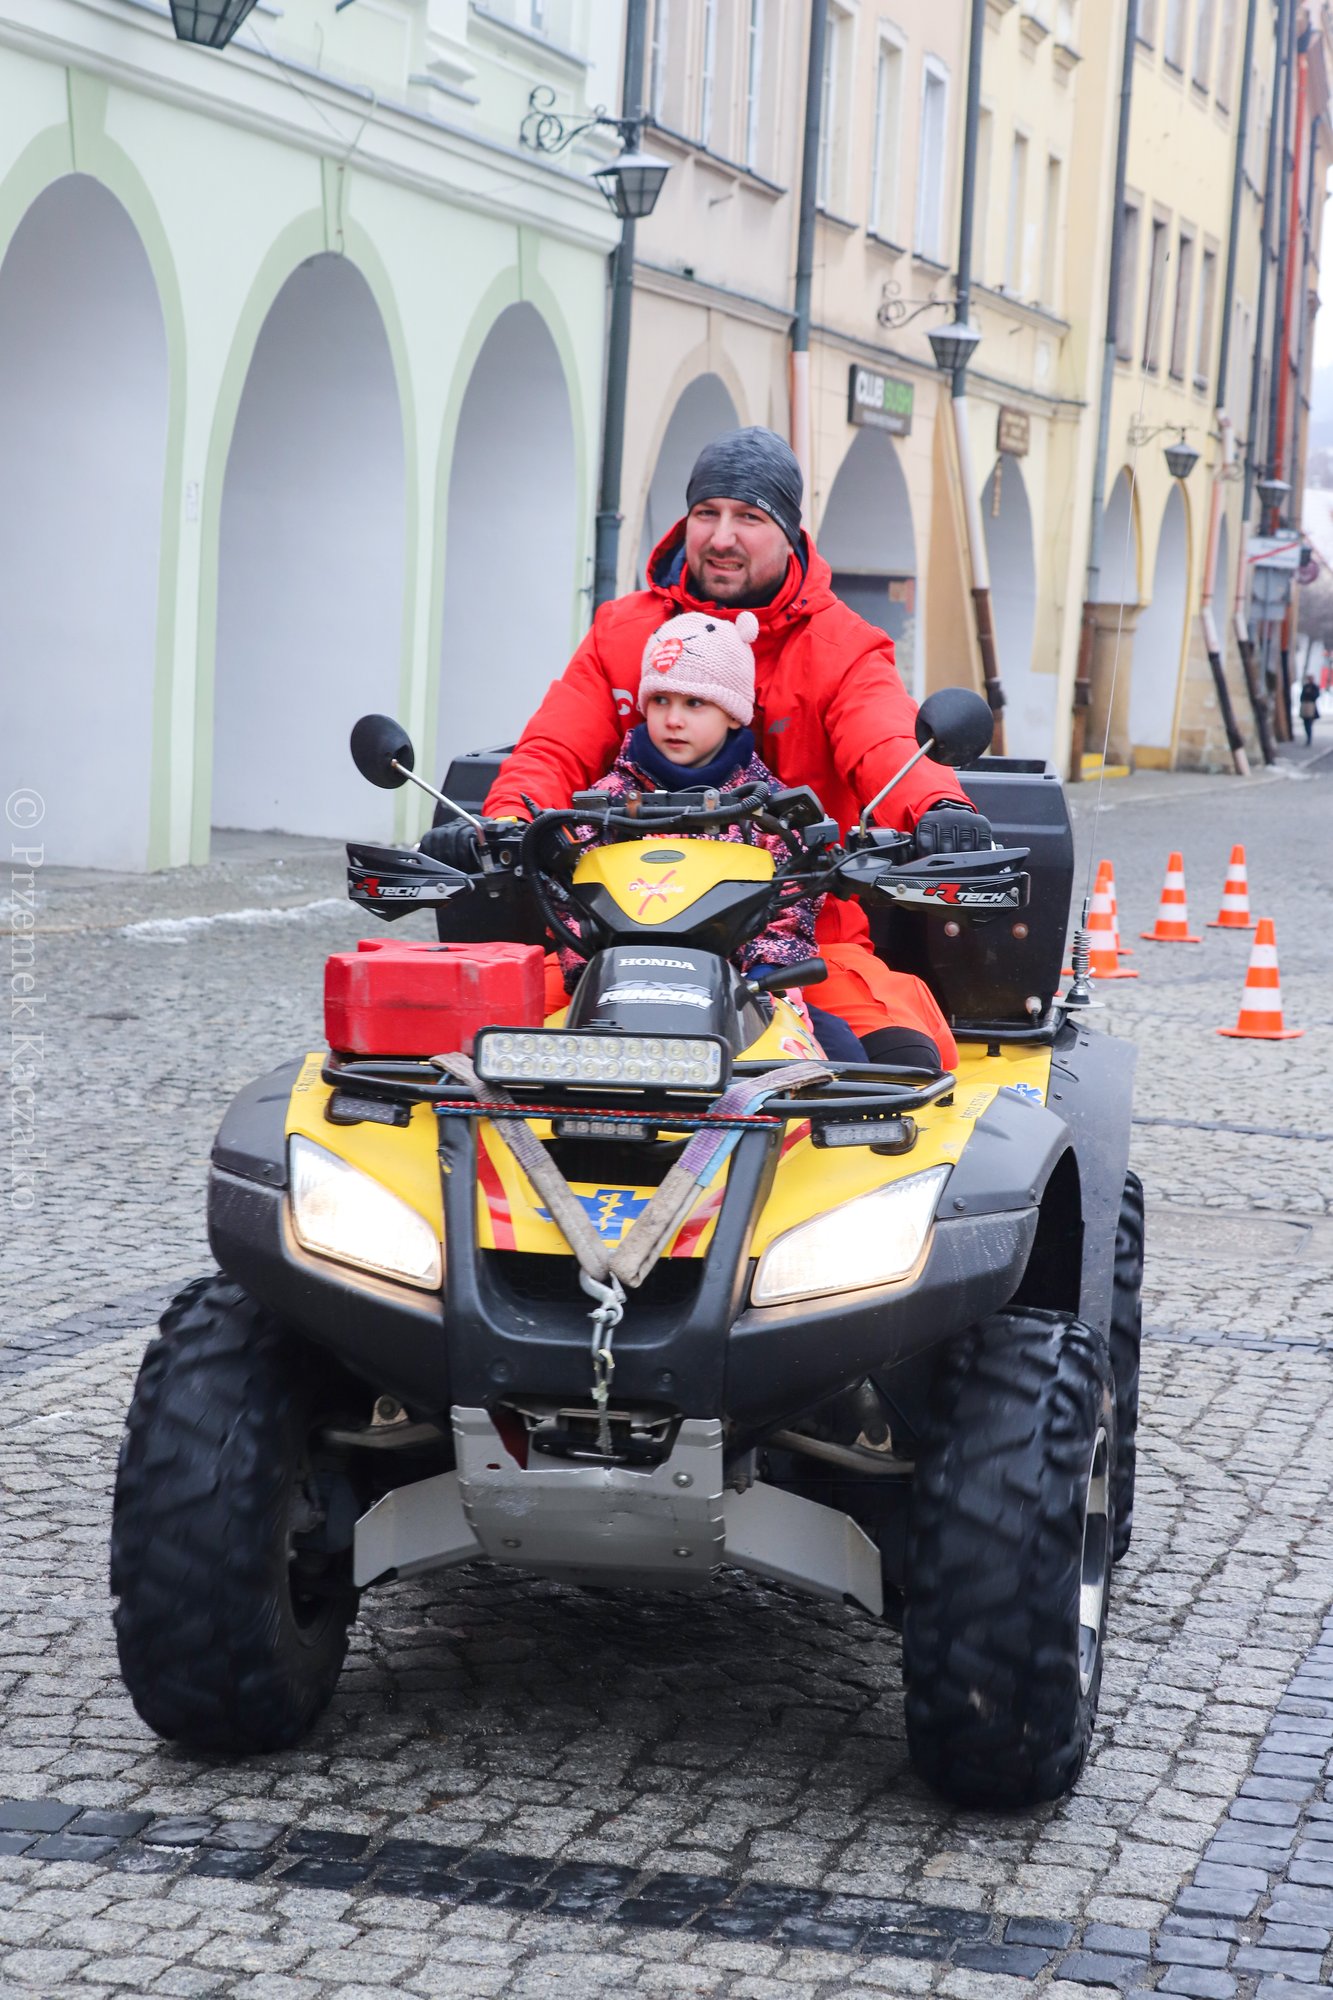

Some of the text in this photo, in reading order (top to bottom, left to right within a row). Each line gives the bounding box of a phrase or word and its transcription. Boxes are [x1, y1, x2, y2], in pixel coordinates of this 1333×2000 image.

[855, 370, 885, 408] CLUB
[618, 958, 697, 971] HONDA
[596, 989, 714, 1008] RINCON
